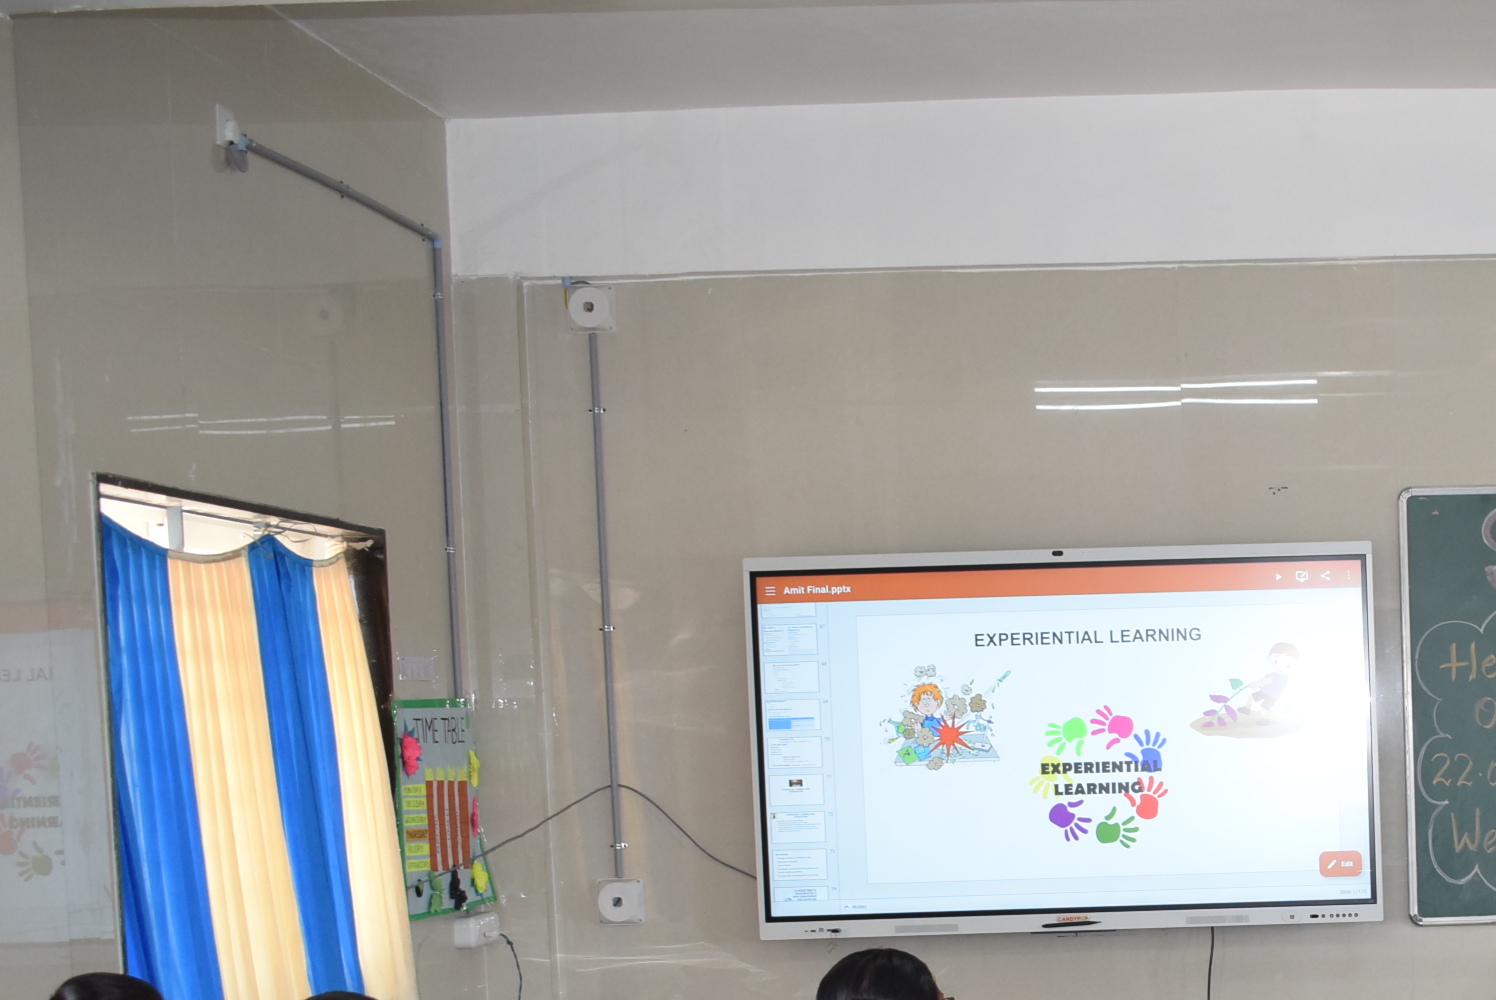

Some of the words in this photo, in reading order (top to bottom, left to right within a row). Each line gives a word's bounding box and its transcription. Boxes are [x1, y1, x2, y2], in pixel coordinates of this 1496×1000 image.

[783, 586, 805, 595] Amit
[807, 585, 852, 596] Final.pptx
[973, 630, 1105, 648] EXPERIENTIAL
[1109, 627, 1202, 645] LEARNING
[413, 717, 439, 744] TIME
[440, 716, 465, 744] TABLE
[1040, 759, 1163, 775] EXPERIENTIAL
[1053, 779, 1144, 796] LEARNING
